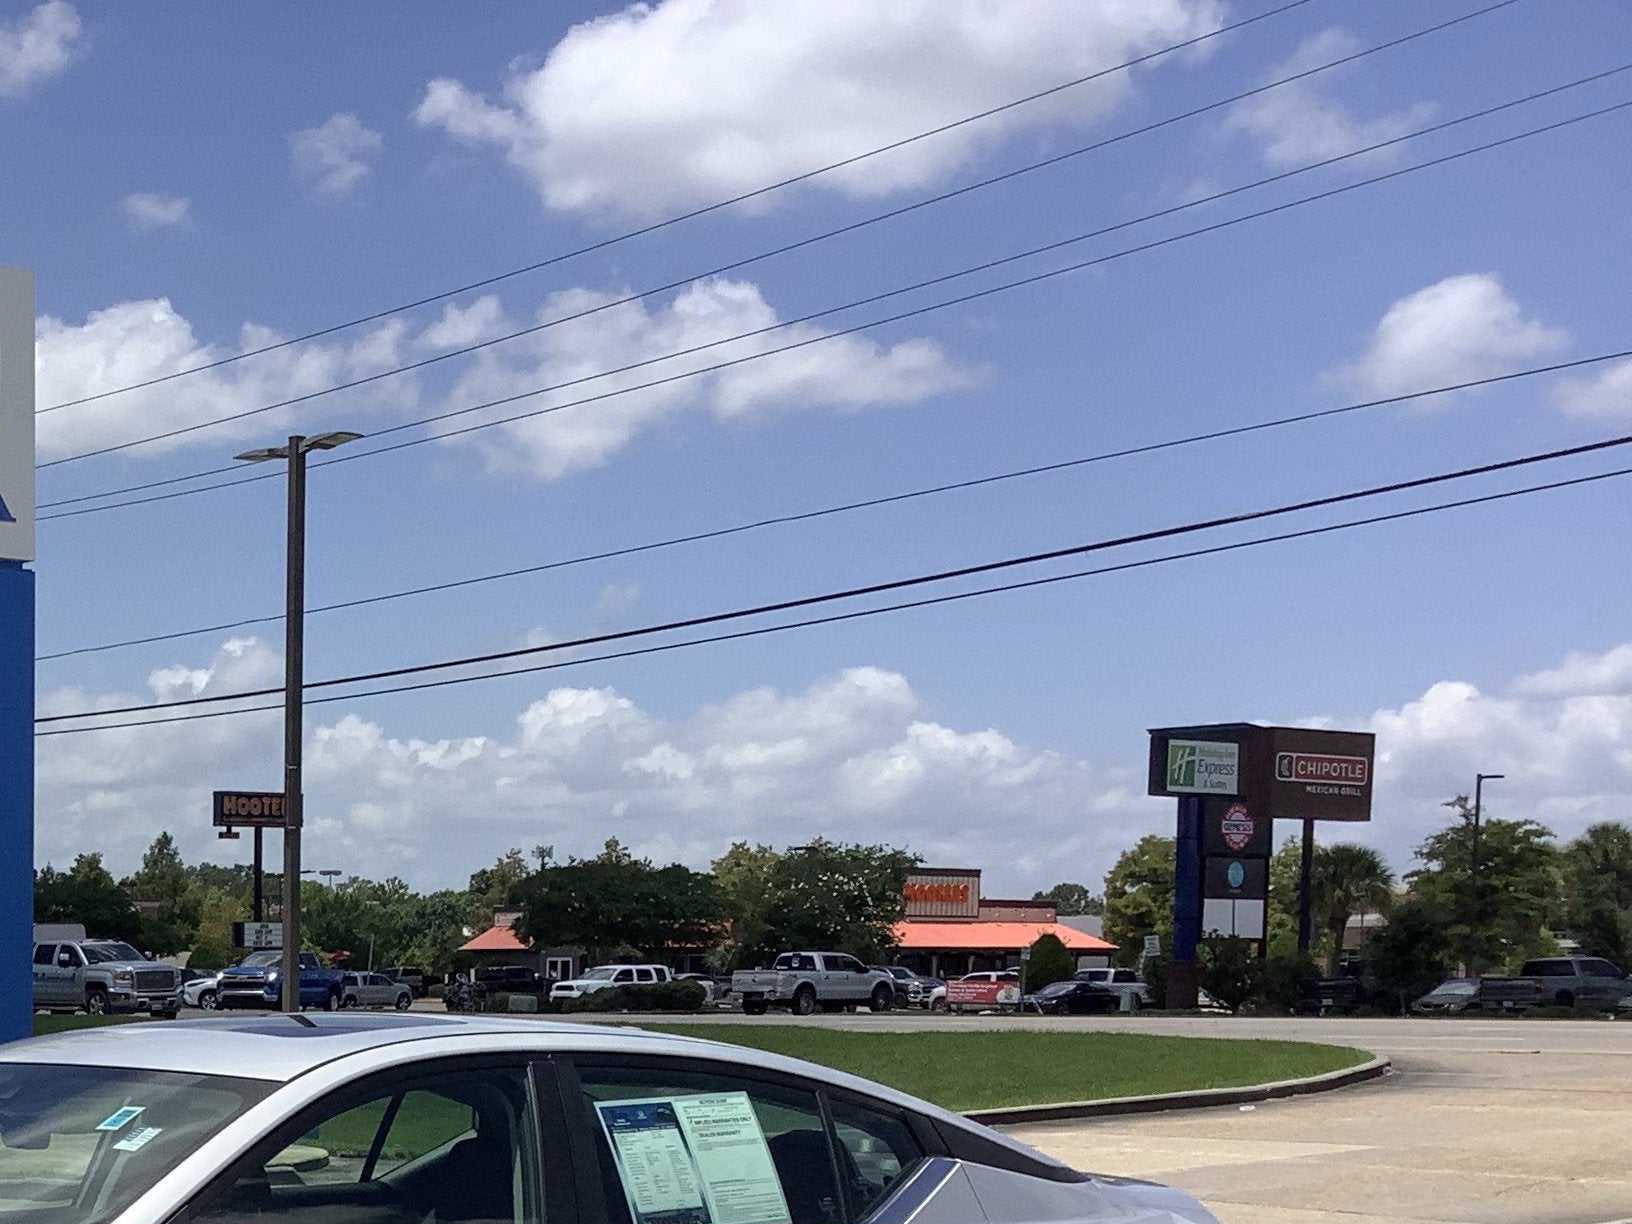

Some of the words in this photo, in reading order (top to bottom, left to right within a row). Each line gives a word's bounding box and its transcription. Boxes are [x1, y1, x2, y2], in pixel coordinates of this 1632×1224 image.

[1197, 759, 1235, 777] Express
[1297, 760, 1364, 778] CHIPOTLE
[1306, 785, 1339, 795] MEXICAN
[1340, 787, 1362, 797] GRILL
[223, 795, 285, 816] HOOTE
